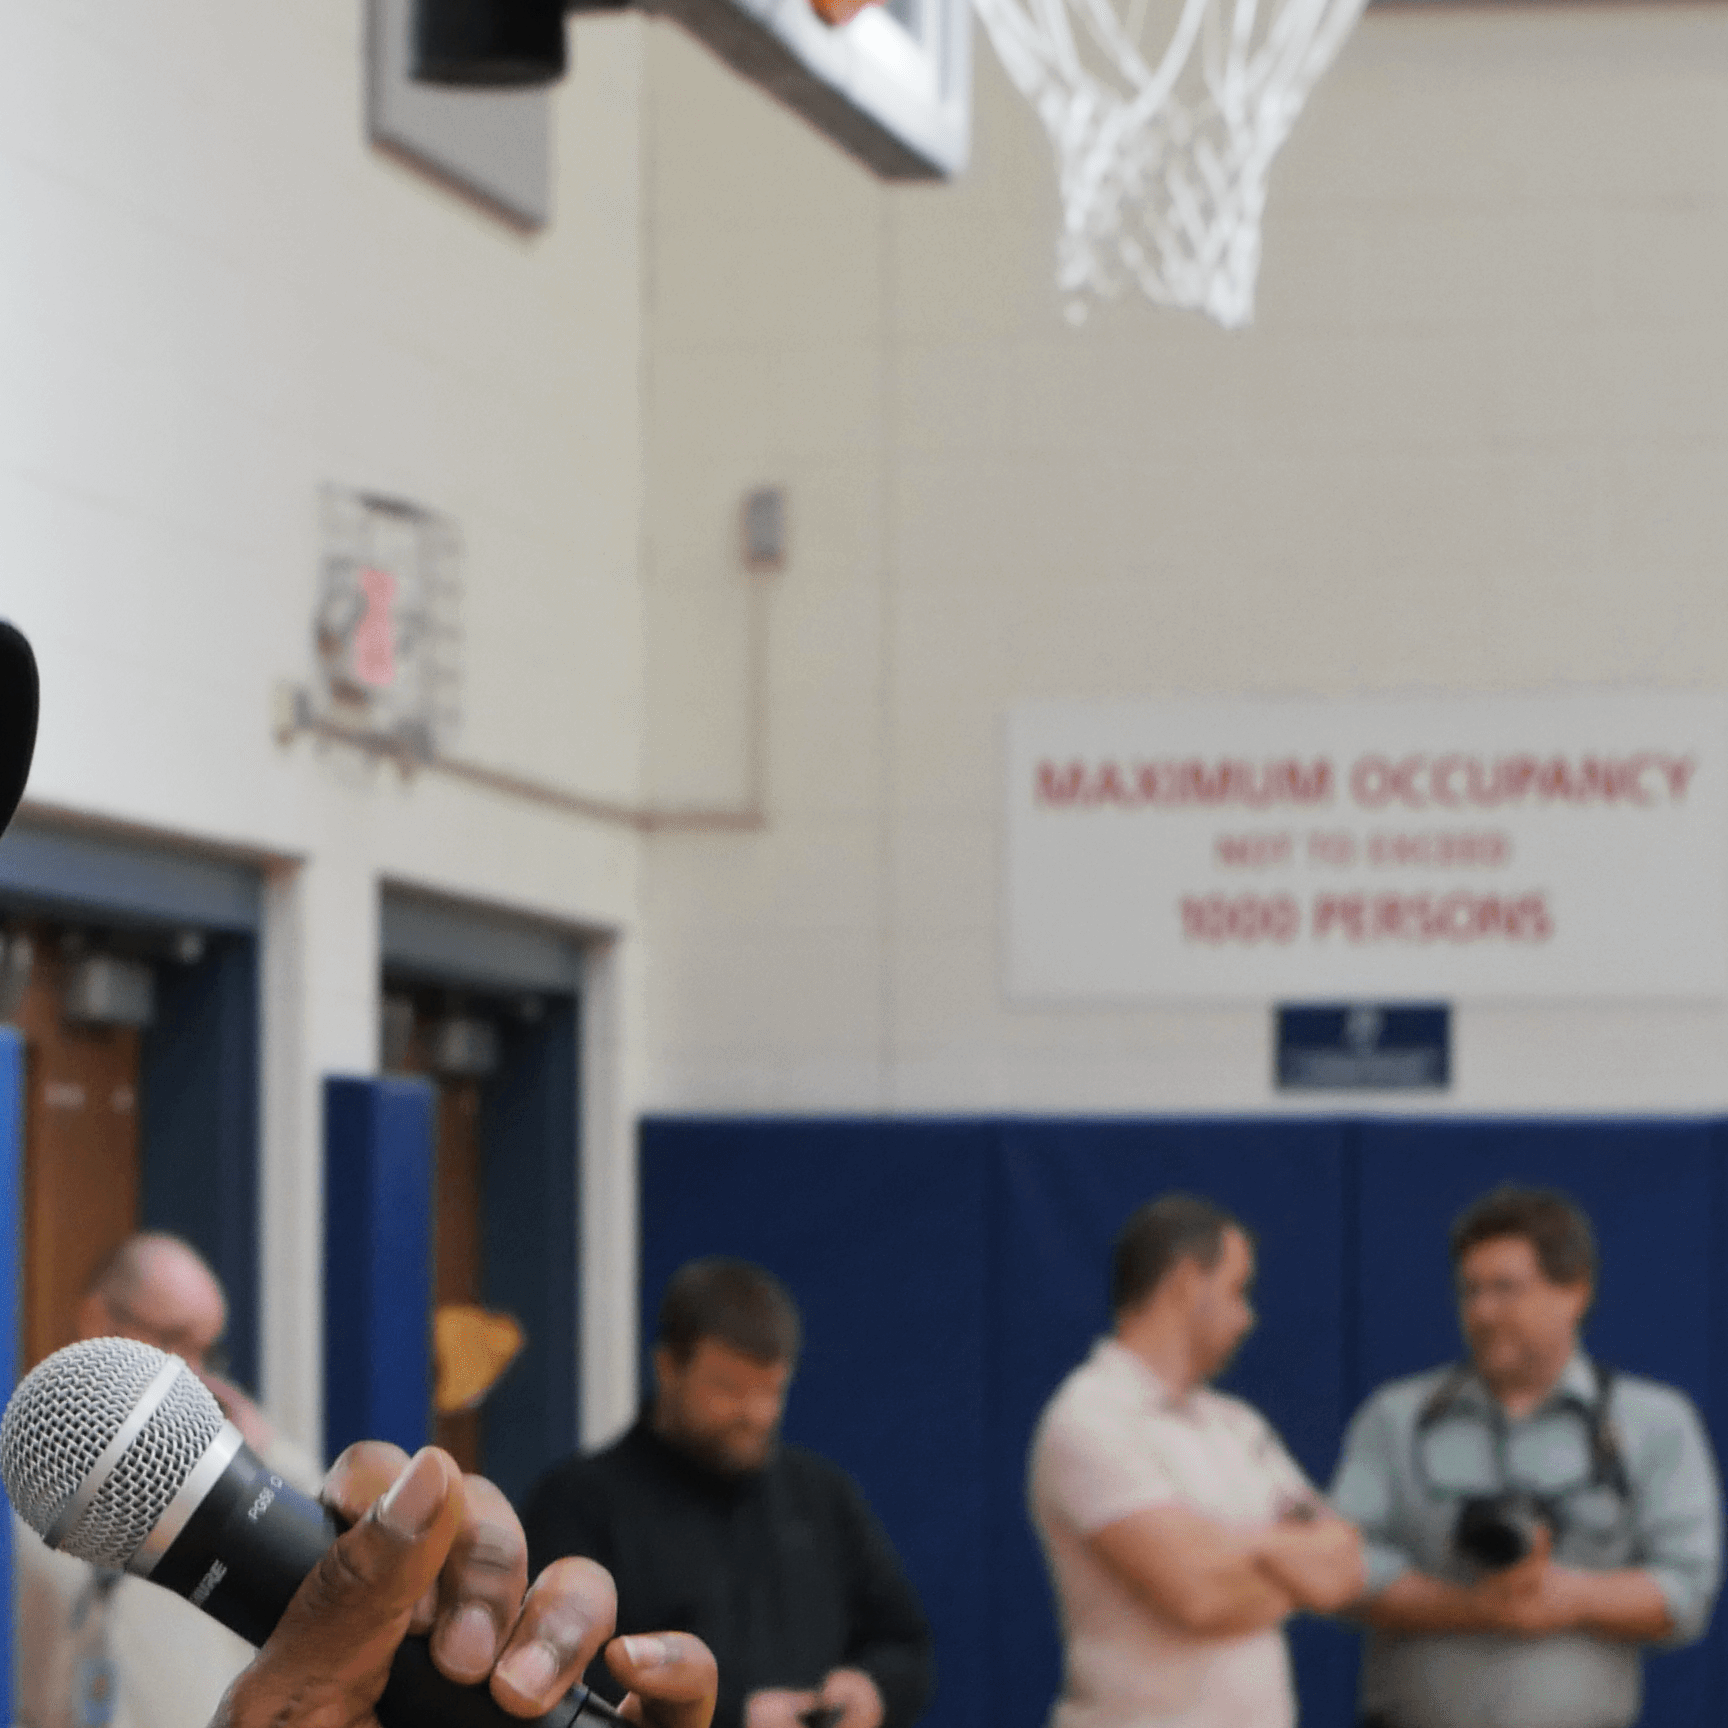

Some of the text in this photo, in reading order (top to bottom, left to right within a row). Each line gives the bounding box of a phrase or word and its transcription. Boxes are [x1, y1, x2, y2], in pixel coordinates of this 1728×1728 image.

[1032, 753, 1695, 808] MAXIMUM OCCUPANCY
[1179, 892, 1553, 942] 1000 PERSONS
